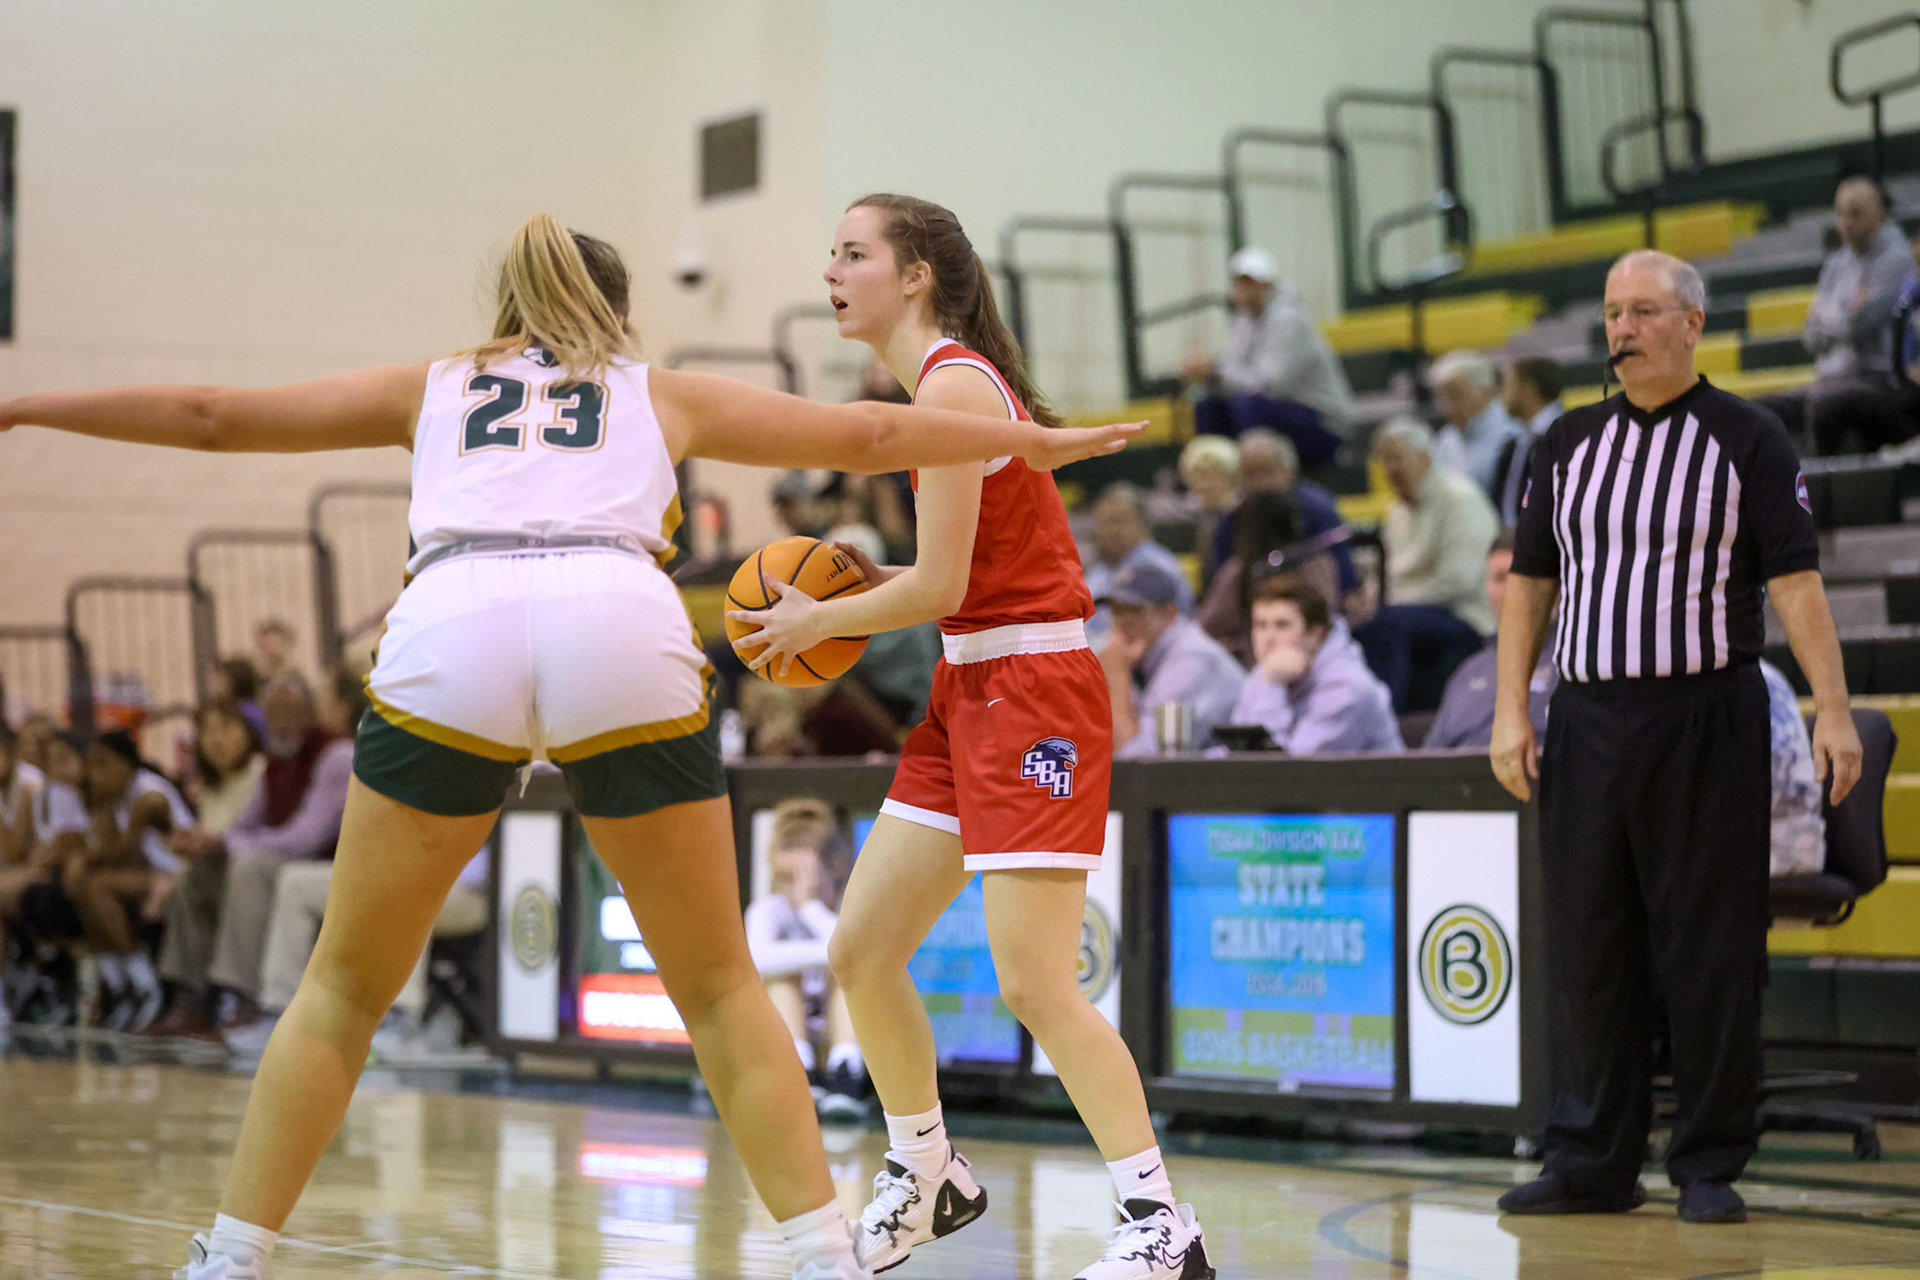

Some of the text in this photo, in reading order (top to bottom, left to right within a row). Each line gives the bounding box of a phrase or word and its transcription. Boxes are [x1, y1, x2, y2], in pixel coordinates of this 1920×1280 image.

[459, 371, 611, 456] 23
[1022, 750, 1072, 797] SBA
[1238, 864, 1324, 906] STATE
[1211, 916, 1366, 965] CHAMPIONS
[1441, 930, 1488, 1000] B
[1182, 1028, 1394, 1074] BOYS BASKETBALL
